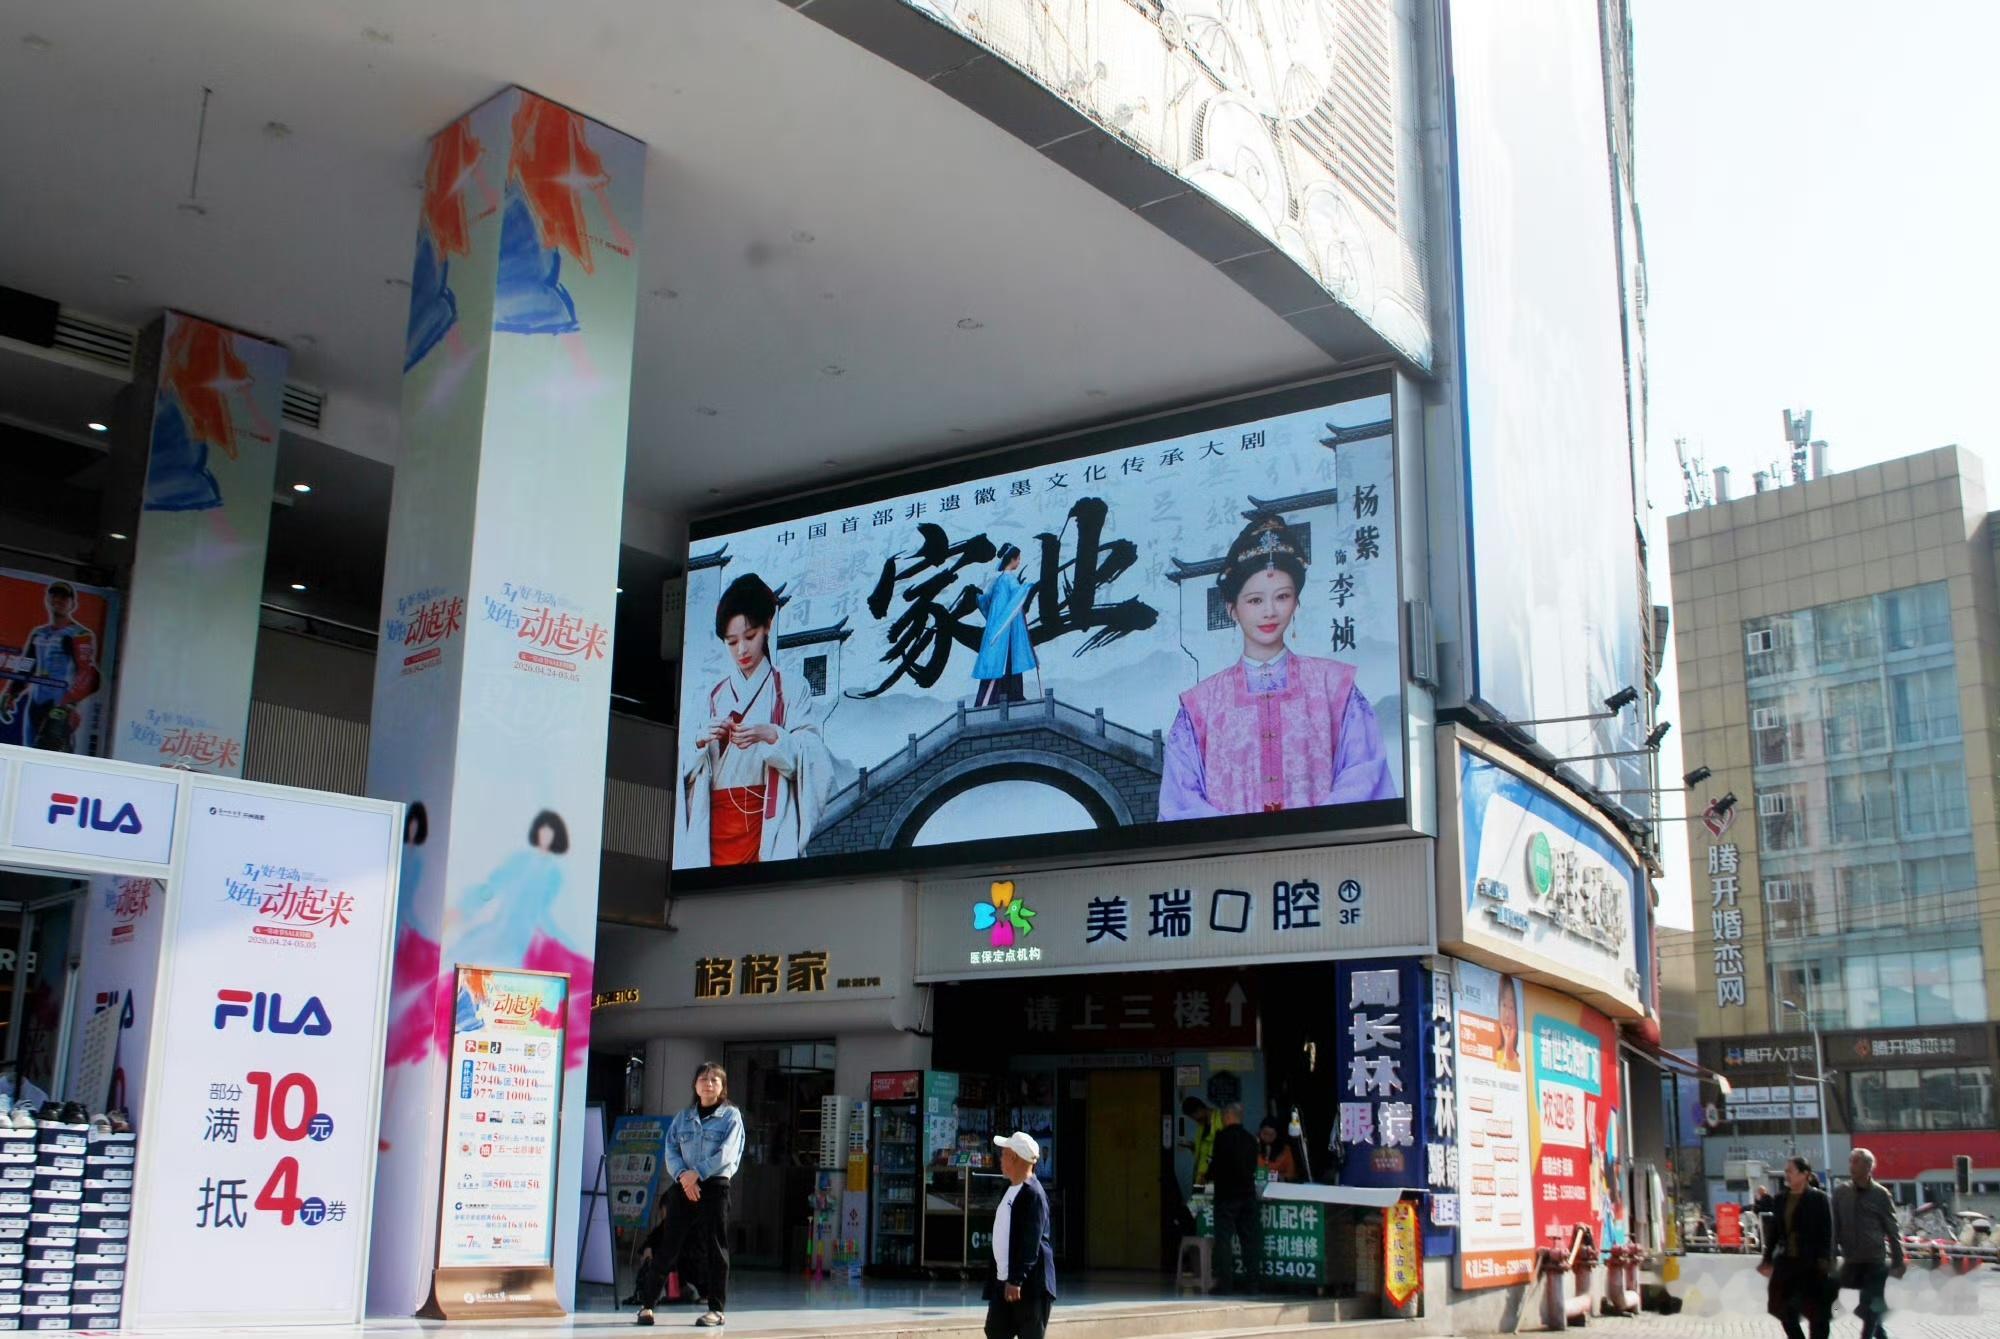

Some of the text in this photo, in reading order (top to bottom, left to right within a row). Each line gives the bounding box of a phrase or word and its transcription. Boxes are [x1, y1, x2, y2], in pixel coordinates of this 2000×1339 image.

[777, 430, 1265, 547] 中国首部非遗徽墨文化传承大剧
[1353, 484, 1380, 561] 杨紫
[48, 793, 142, 834] FILA
[1086, 878, 1321, 943] 美瑞口腔
[1339, 909, 1361, 925] 3F
[1708, 844, 1746, 1008] 腾开婚恋网
[695, 950, 829, 999] 格格家
[970, 946, 1041, 965] 医保定点机构
[214, 989, 332, 1036] FILA
[1025, 990, 1211, 1031] 请上三楼
[210, 1083, 243, 1101] 部分
[1340, 1101, 1414, 1148] 眼镜
[1263, 1235, 1318, 1258] 手机维修
[1260, 1261, 1316, 1278] 35402
